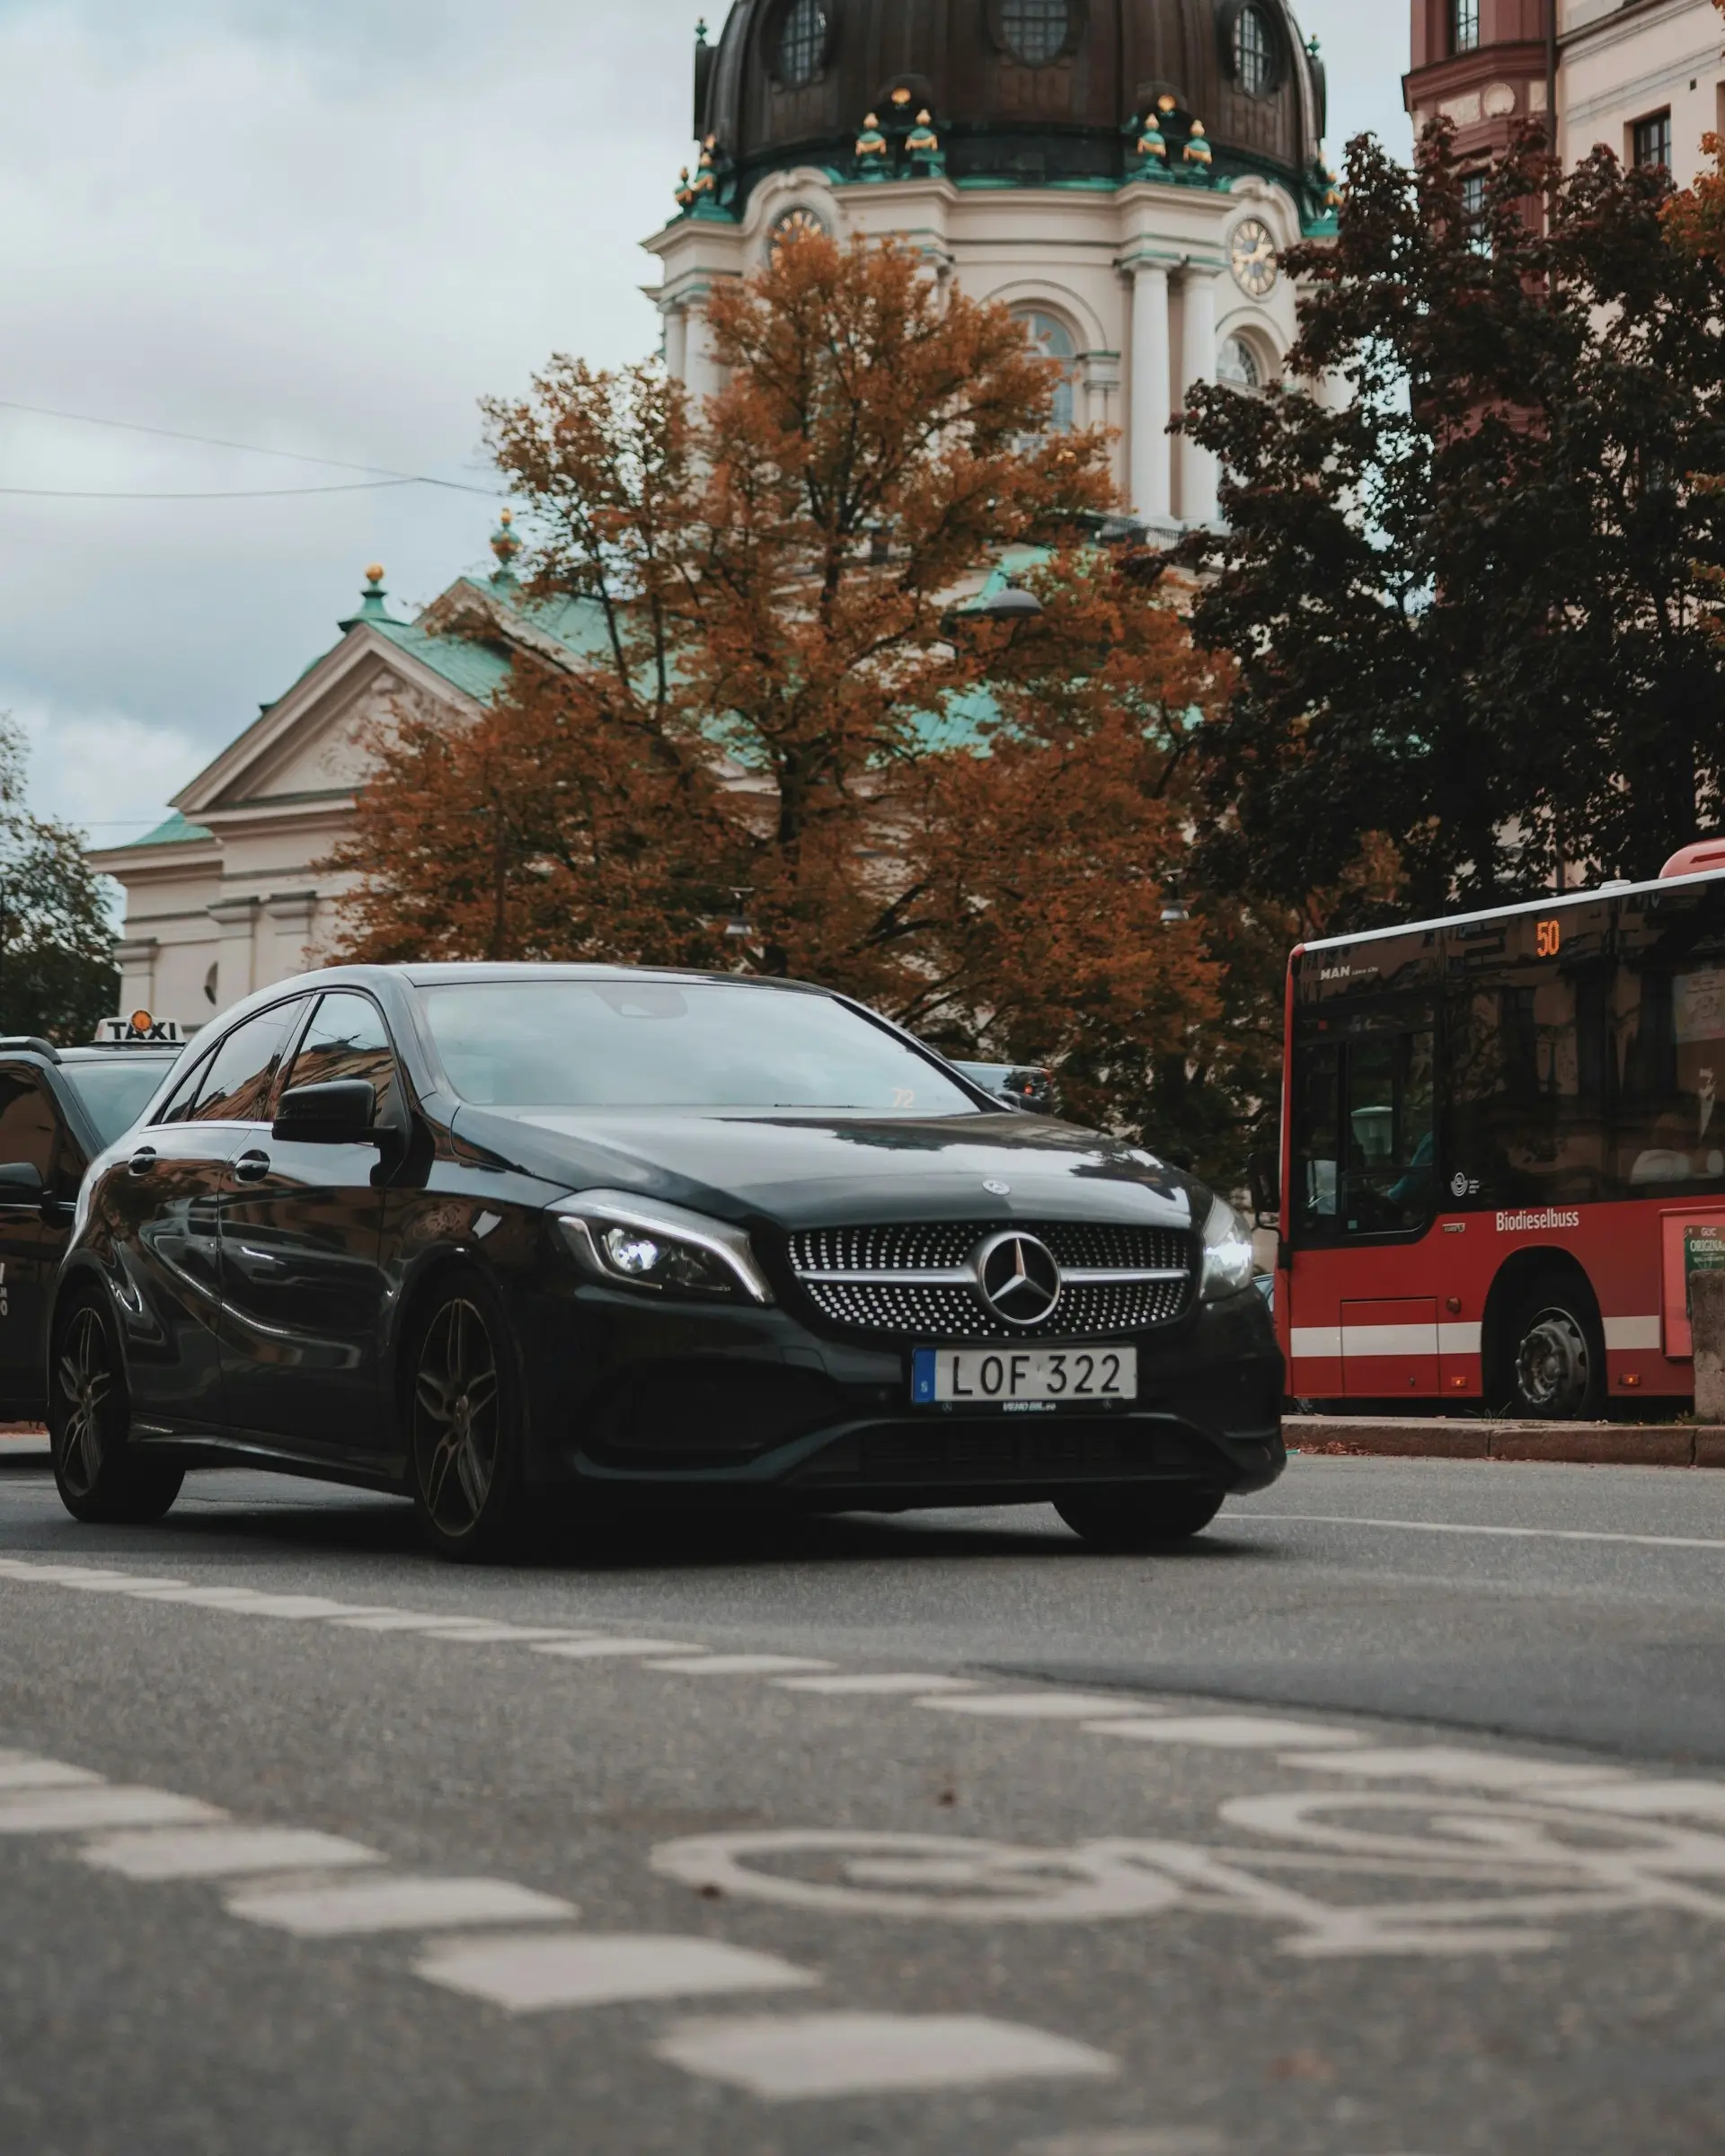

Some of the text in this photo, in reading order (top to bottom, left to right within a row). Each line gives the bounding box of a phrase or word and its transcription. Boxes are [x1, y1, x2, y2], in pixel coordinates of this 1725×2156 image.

[1537, 920, 1560, 957] 50
[1320, 965, 1351, 981] MAN
[107, 1021, 176, 1040] TAXI
[889, 1087, 915, 1108] 72
[1495, 1208, 1579, 1232] Biodieselbuss
[952, 1354, 1120, 1395] LOF 322
[920, 1381, 928, 1392] S
